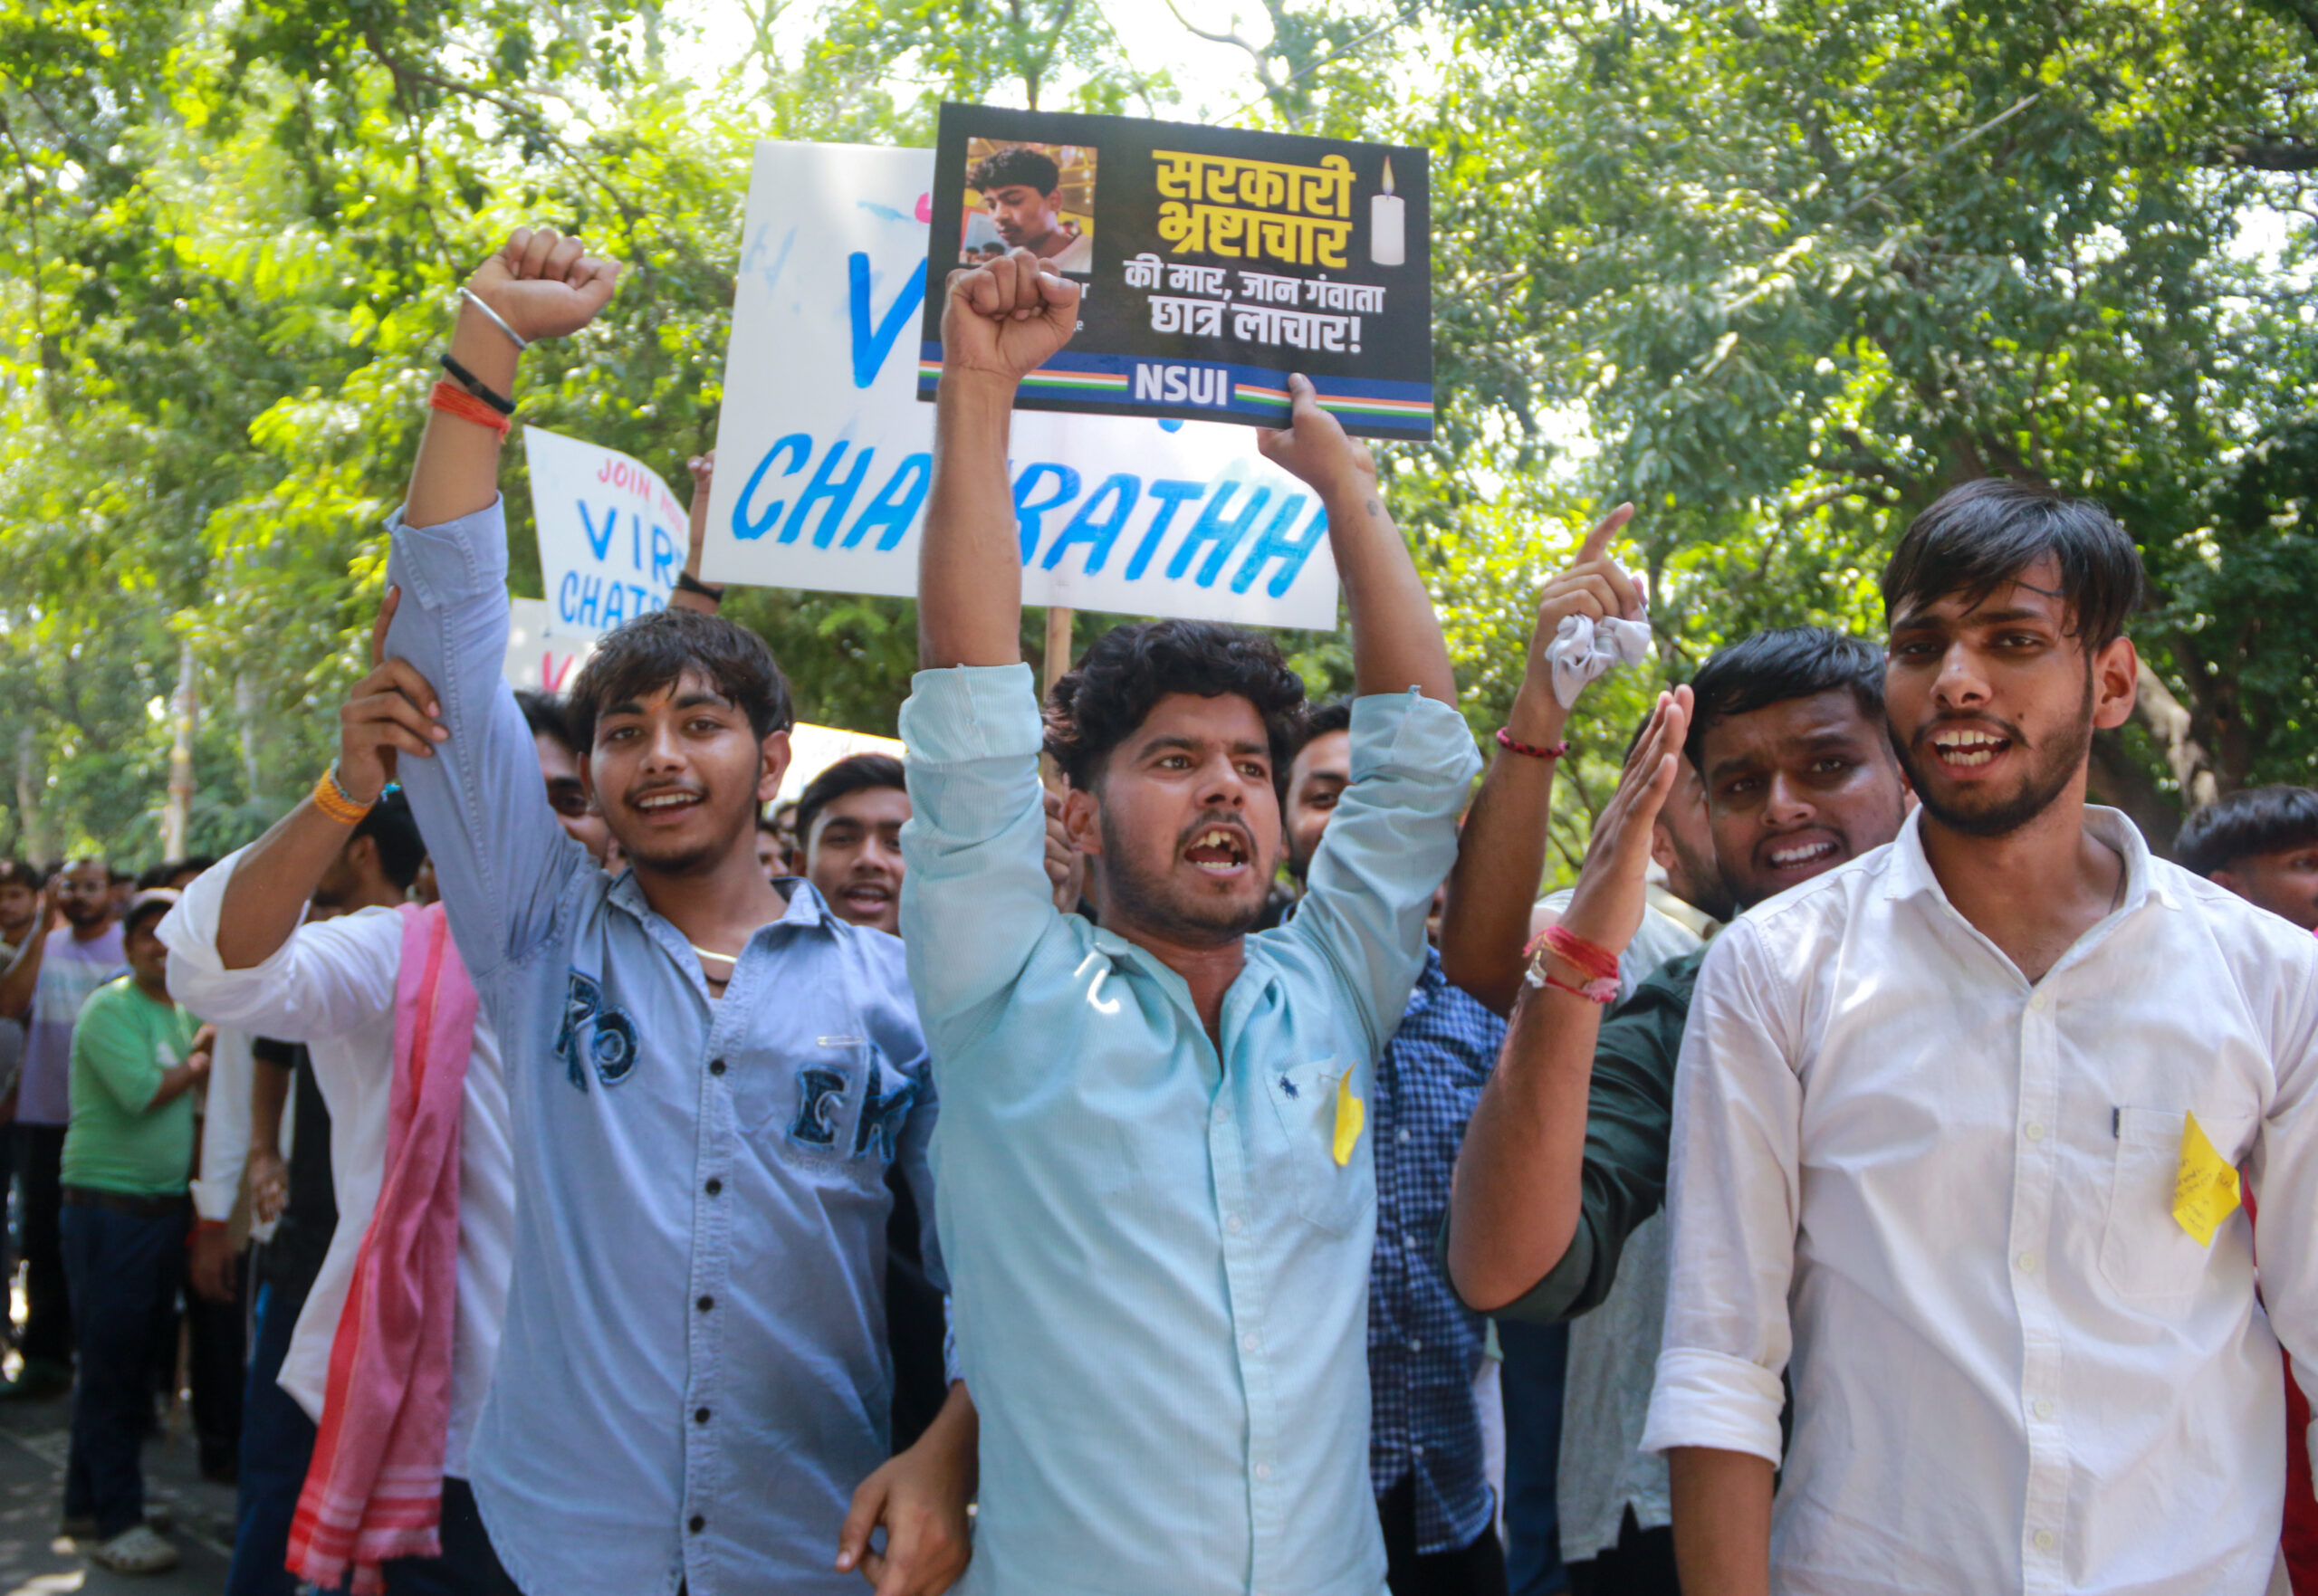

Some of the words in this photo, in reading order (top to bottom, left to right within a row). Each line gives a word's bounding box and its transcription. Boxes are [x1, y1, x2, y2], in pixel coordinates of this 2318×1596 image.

[1152, 149, 1356, 217] सरकारी
[1157, 201, 1353, 268] भ्रष्टाचार
[1123, 253, 1164, 289] की
[1167, 263, 1232, 301] मार,
[1238, 271, 1301, 305] जान
[1305, 273, 1386, 313] गंवाता
[1147, 295, 1226, 338] छात्र
[1231, 303, 1361, 353] लाचार!
[1135, 363, 1228, 406] NSUI
[597, 457, 651, 502] JOIN
[732, 433, 1329, 598] CHARATHH
